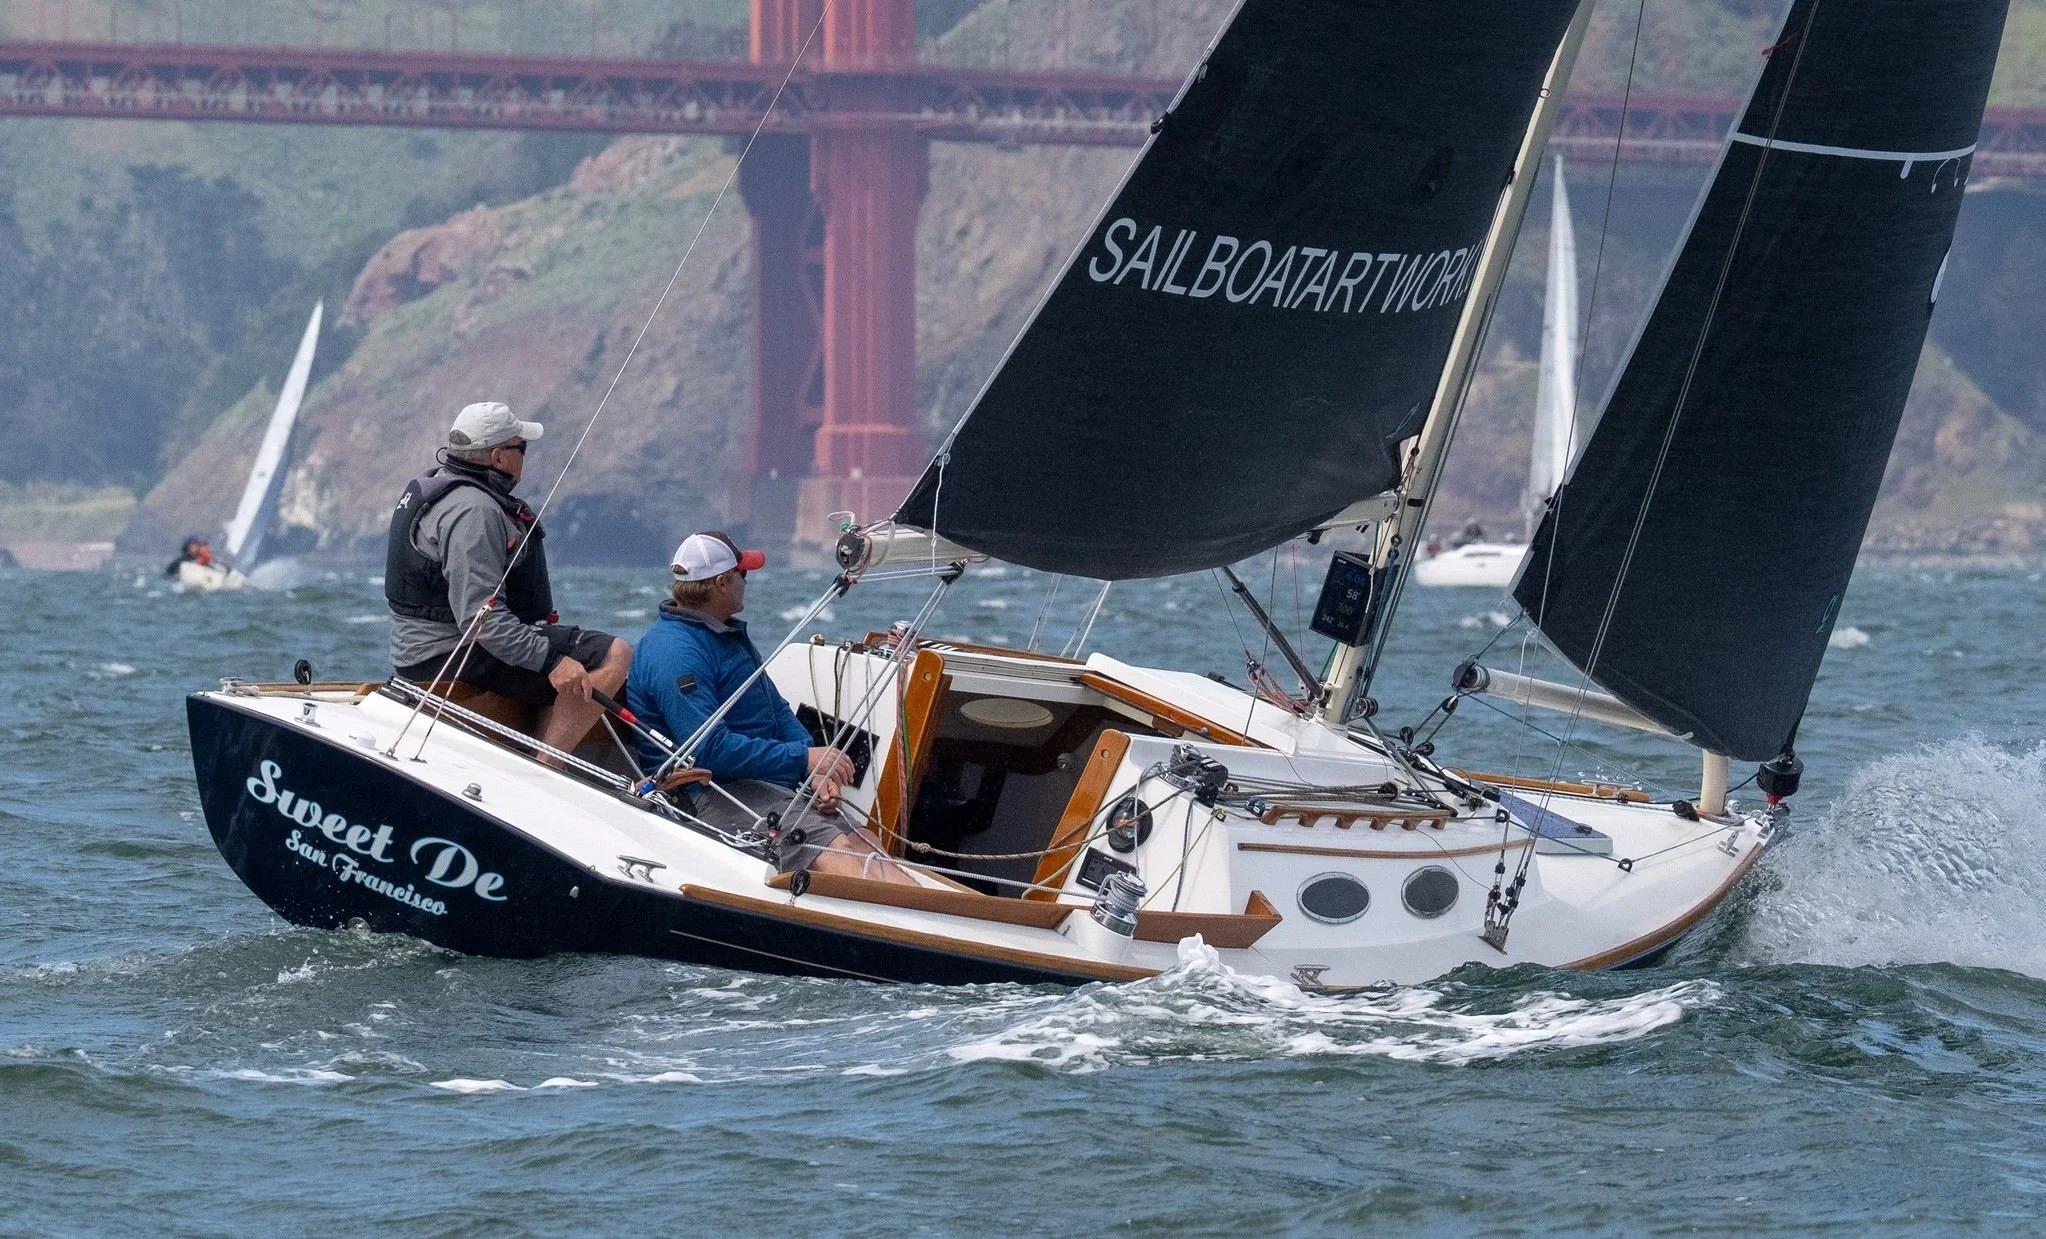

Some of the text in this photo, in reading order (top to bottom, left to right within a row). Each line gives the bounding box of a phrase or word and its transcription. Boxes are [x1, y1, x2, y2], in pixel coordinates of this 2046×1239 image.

[246, 759, 508, 901] Sweet De
[285, 829, 448, 916] San Francisco
